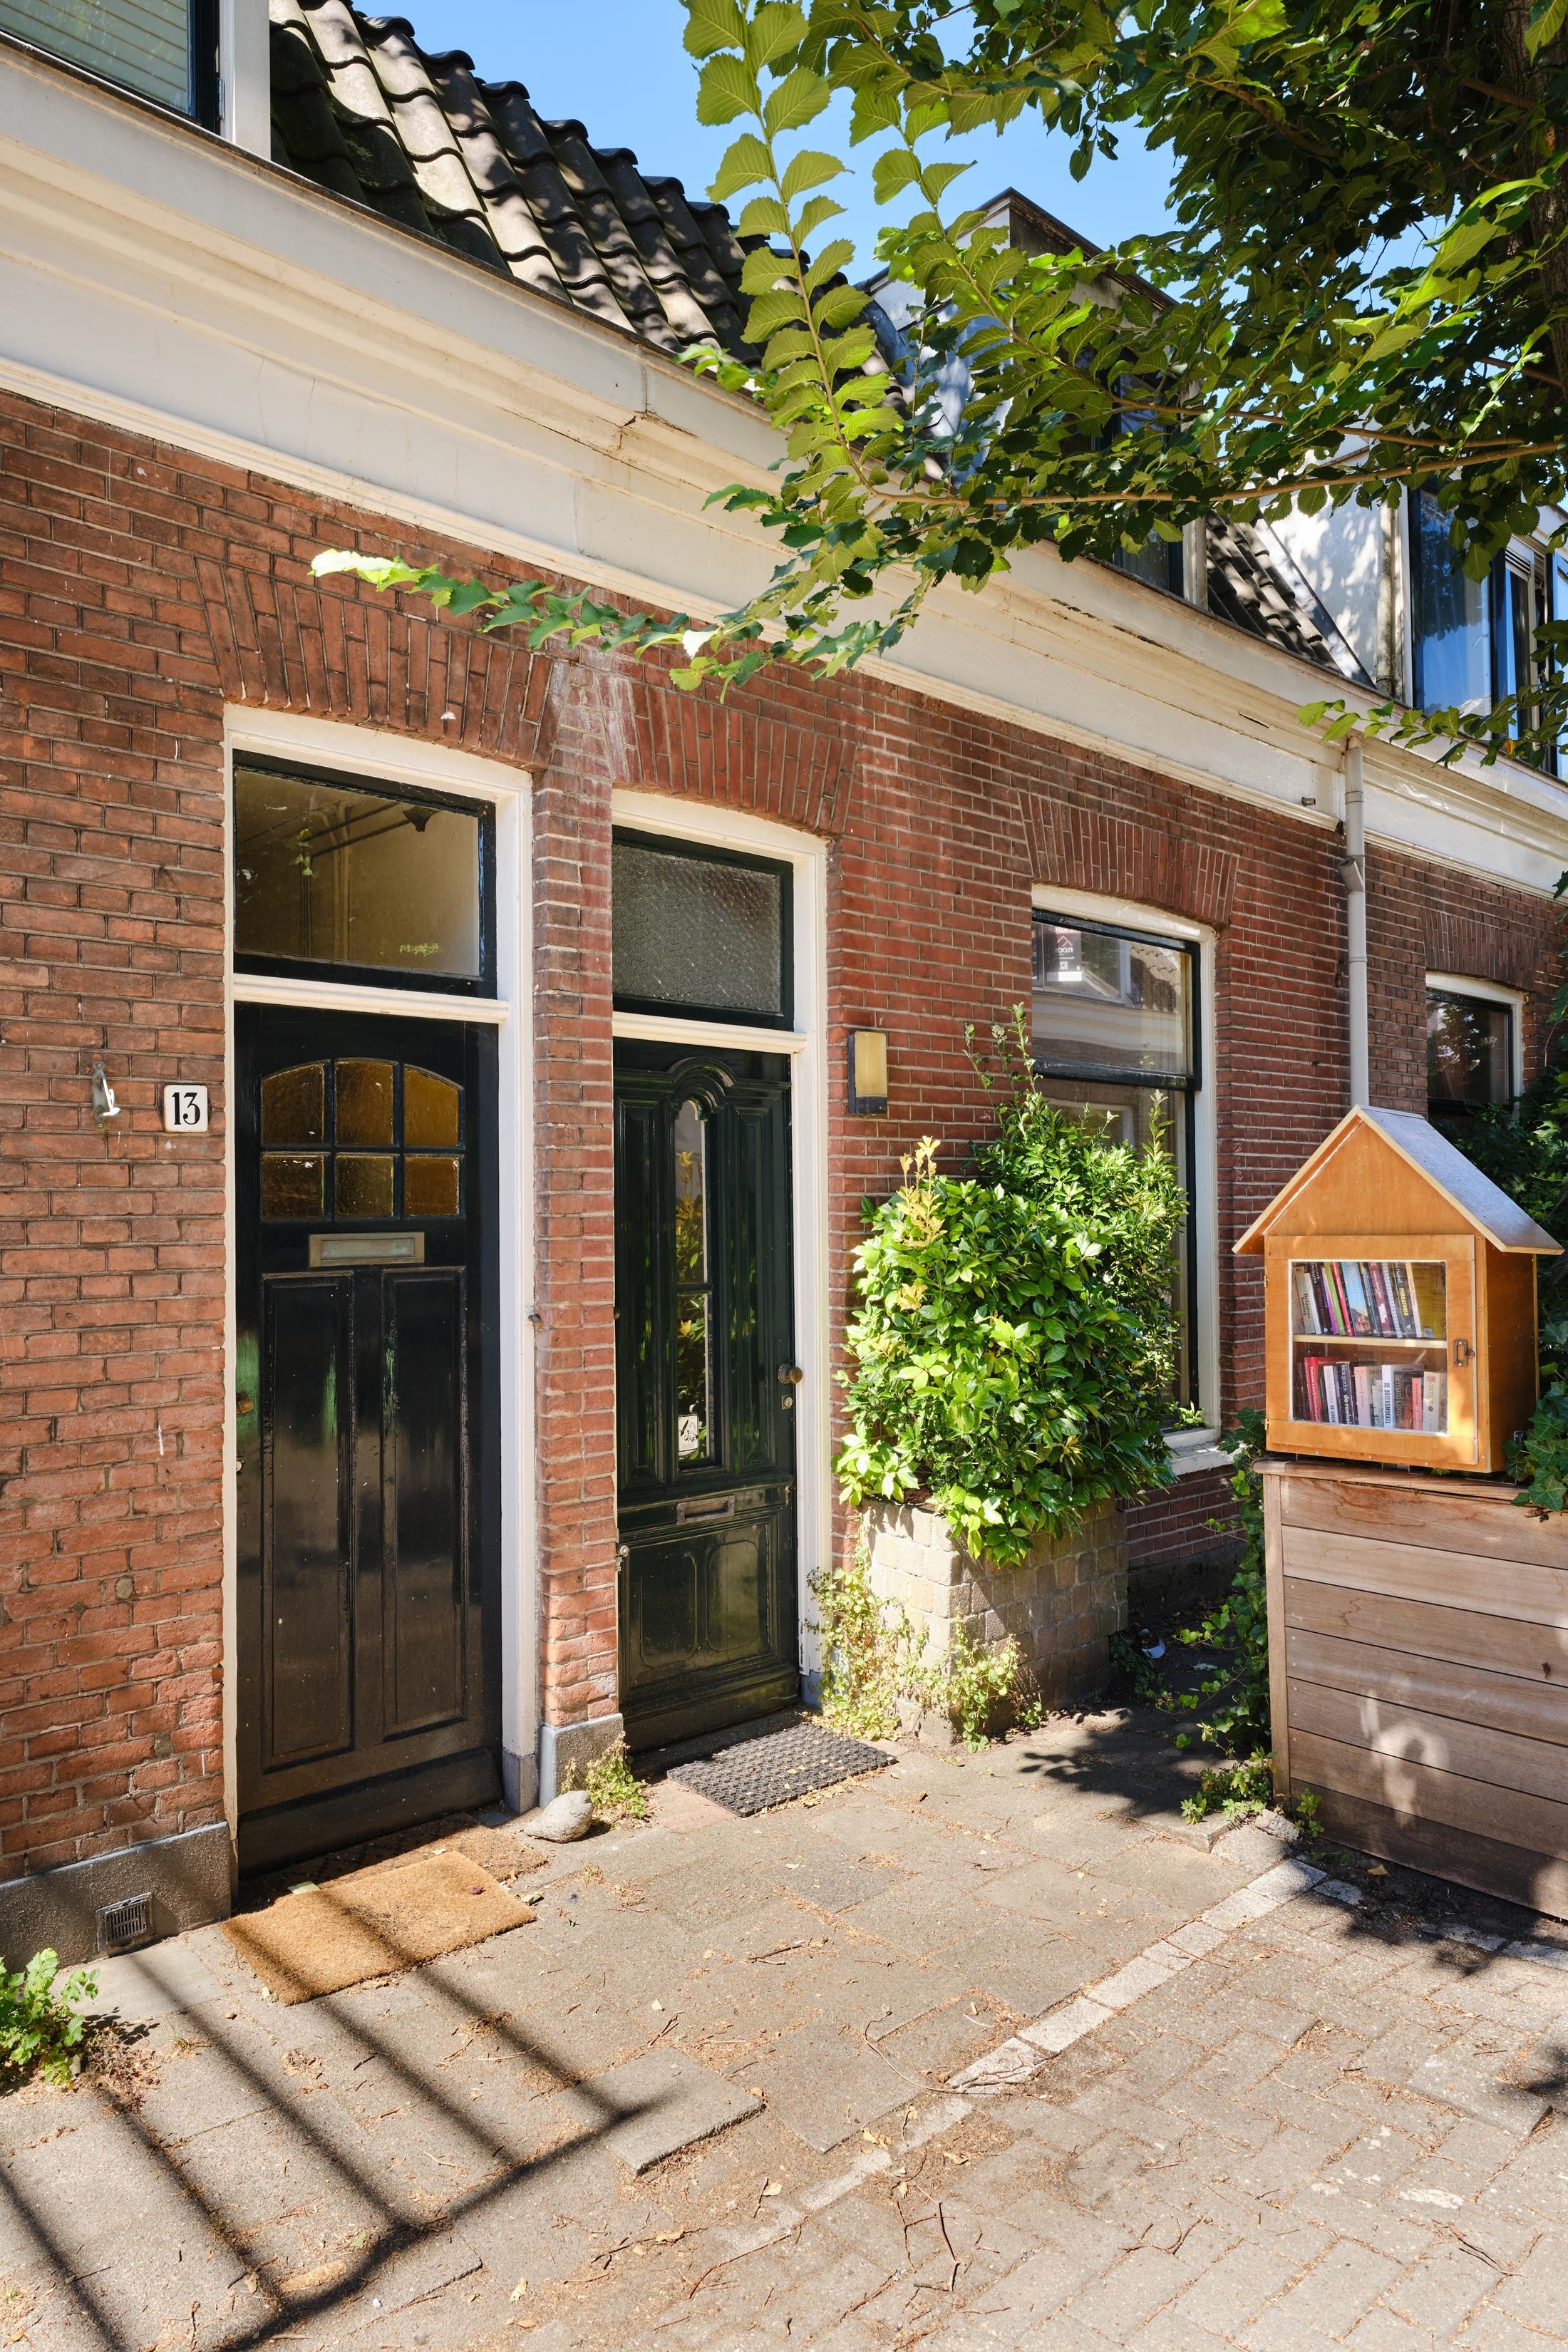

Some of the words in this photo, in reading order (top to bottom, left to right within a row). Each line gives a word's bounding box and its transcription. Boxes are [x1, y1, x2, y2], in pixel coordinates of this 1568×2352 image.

[172, 1092, 201, 1125] 13
[1399, 1288, 1409, 1316] PURGATORIO
[1395, 1375, 1403, 1399] Bernard
